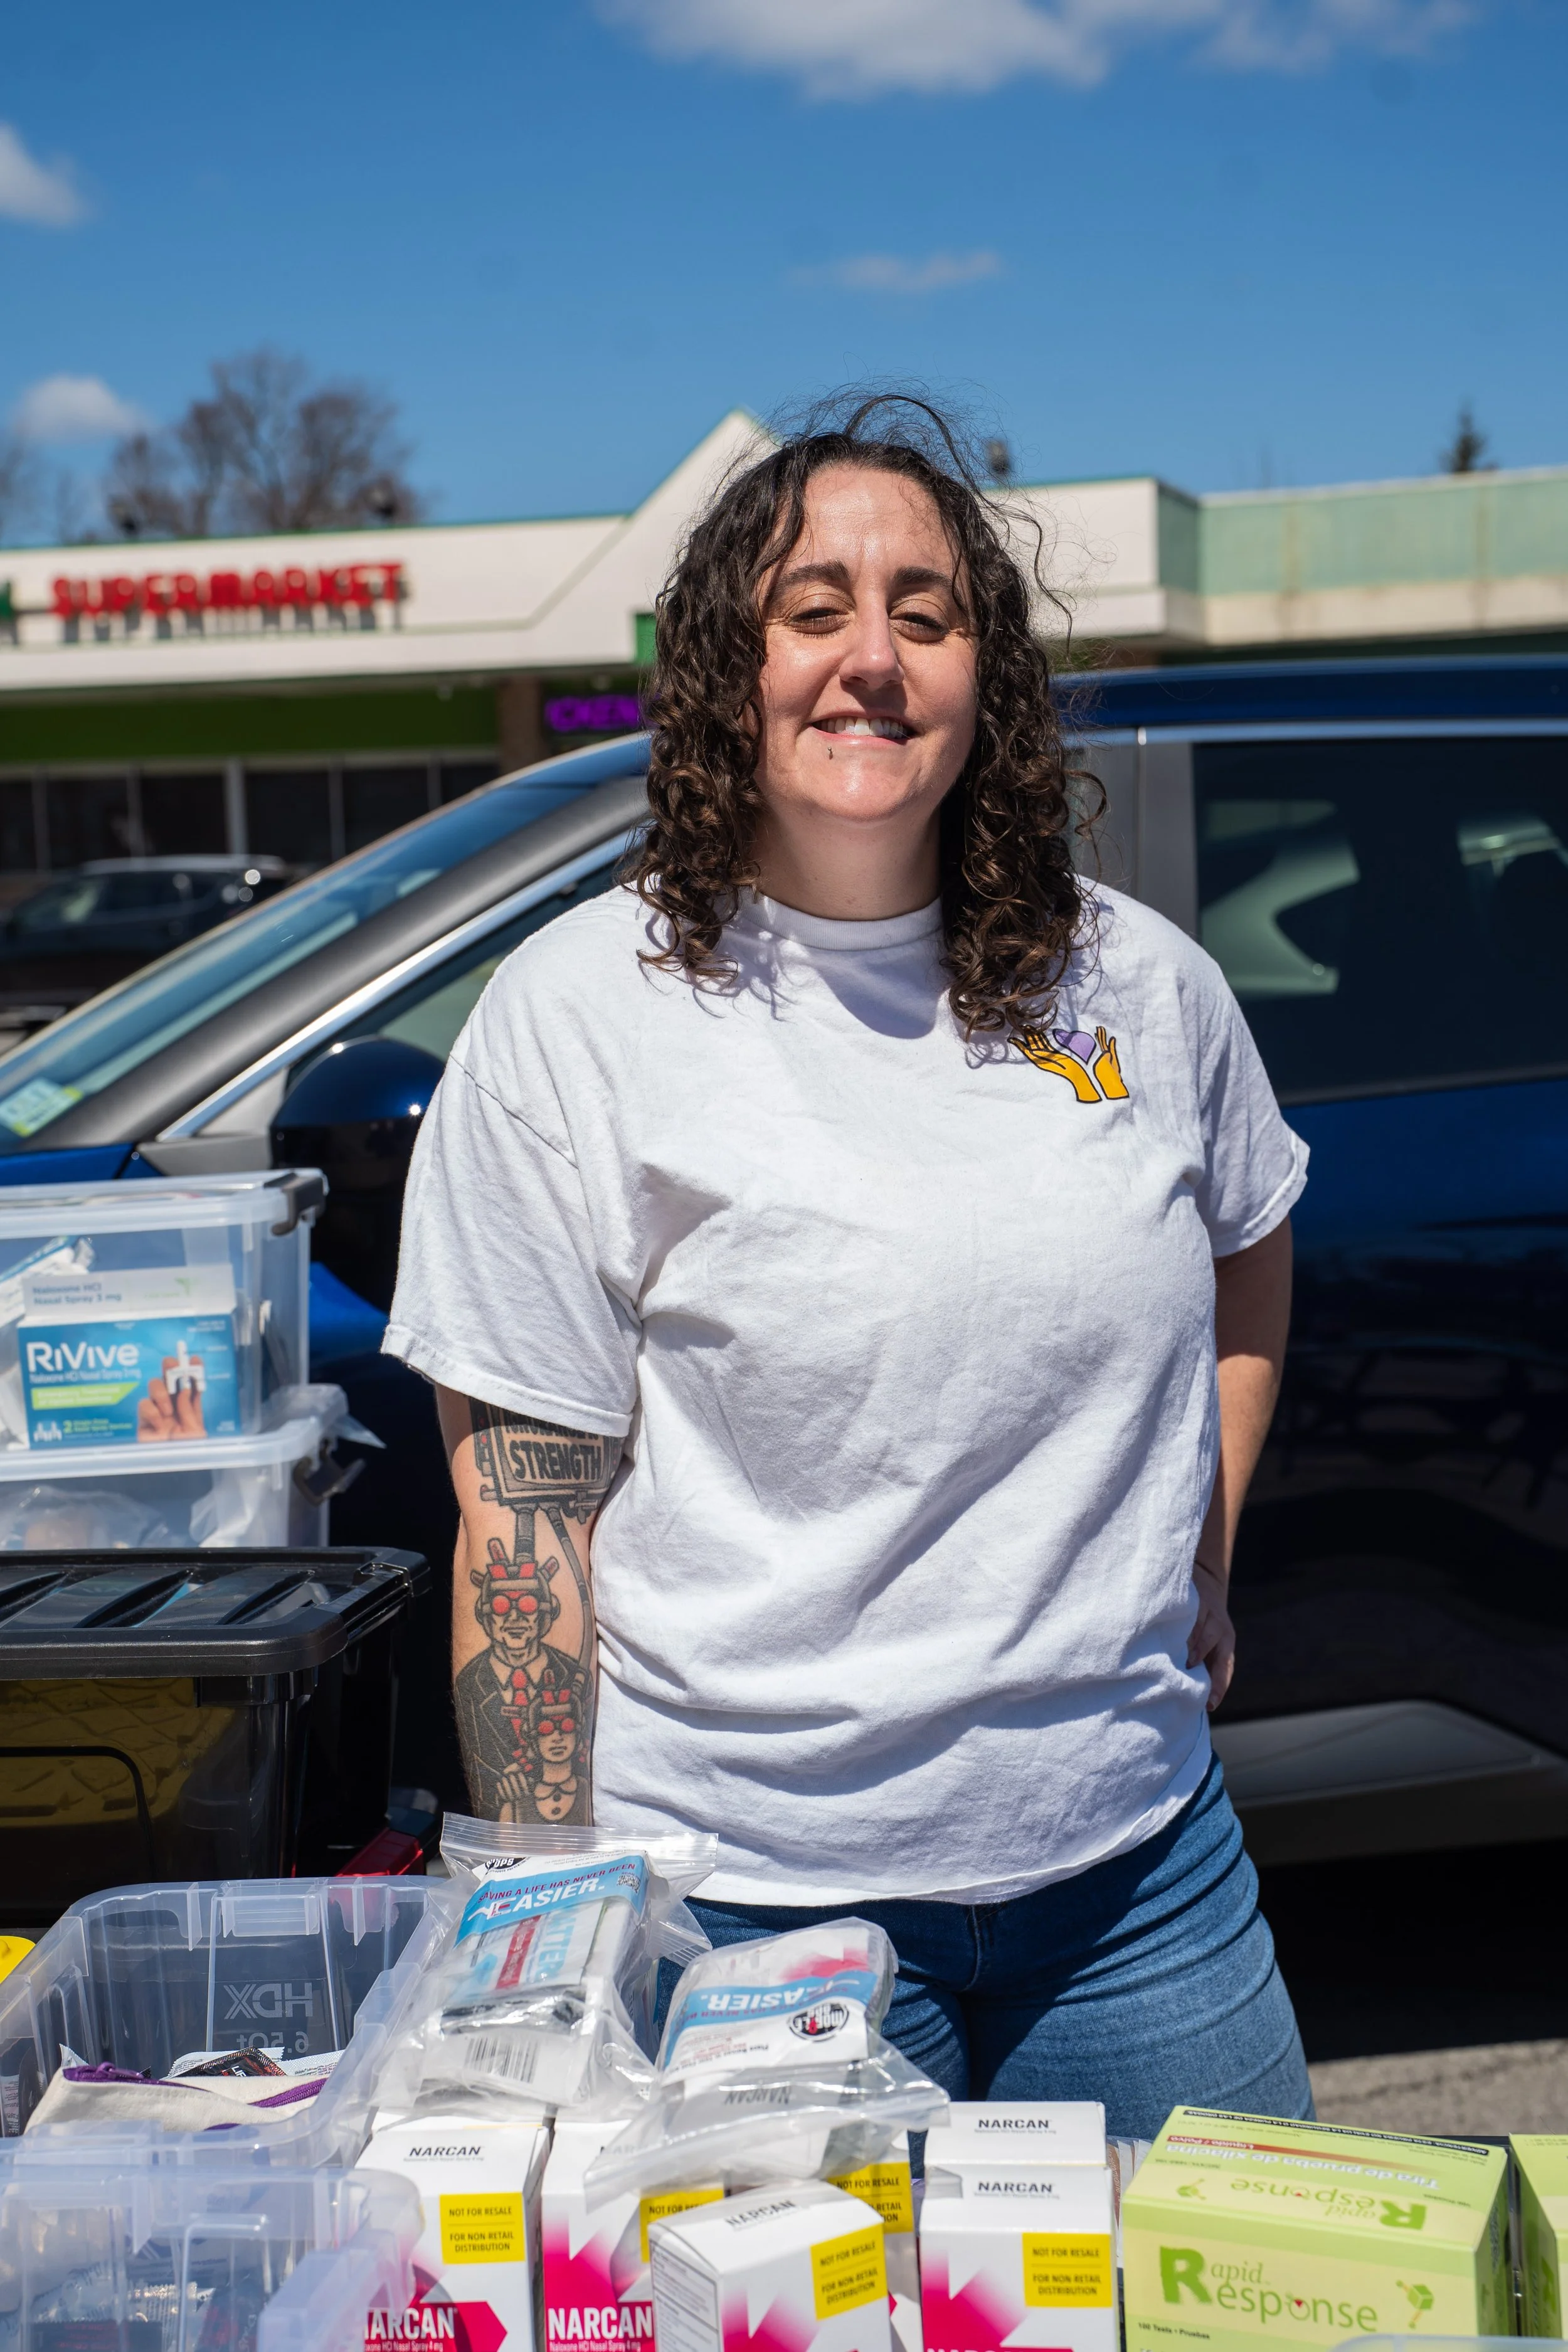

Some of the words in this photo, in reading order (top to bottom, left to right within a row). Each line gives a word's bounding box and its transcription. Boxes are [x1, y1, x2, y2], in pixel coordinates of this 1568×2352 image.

[51, 559, 405, 619] SUPERMARKET
[509, 1440, 601, 1480] STRENGTH
[478, 1890, 515, 1904] SAVING
[516, 1888, 522, 1896] A
[525, 1884, 546, 1894] LIFE
[549, 1880, 569, 1889] HAS
[573, 1871, 605, 1882] NEVER
[609, 1863, 636, 1874] BEEN
[724, 2086, 790, 2104] NARCAN
[978, 2119, 1049, 2129] NARCAN
[410, 2146, 481, 2157] NARCAN
[1167, 2144, 1248, 2159] xilacina
[1252, 2153, 1278, 2164] de
[1283, 2156, 1361, 2174] prueba
[1364, 2167, 1392, 2180] de
[837, 2180, 852, 2190] NOT
[855, 2180, 870, 2189] FOR
[872, 2176, 899, 2187] RESALE
[1397, 2172, 1439, 2190] Tira
[978, 2182, 1052, 2193] NARCAN
[449, 2207, 464, 2217] NOT
[467, 2206, 482, 2217] FOR
[484, 2206, 512, 2216] RESALE
[649, 2205, 665, 2215] NOT
[667, 2205, 683, 2213] FOR
[724, 2200, 796, 2226] NARCAN
[450, 2233, 465, 2242] FOR
[455, 2242, 511, 2253] DISTRIBUTION
[1032, 2248, 1050, 2257] NOT
[1051, 2248, 1067, 2257] FOR
[1070, 2248, 1099, 2258] RESALE
[820, 2257, 835, 2267] NOT
[836, 2250, 850, 2262] FOR
[852, 2241, 876, 2255] RESALE
[1033, 2275, 1049, 2283] FOR
[822, 2283, 836, 2294] FOR
[827, 2281, 876, 2305] DISTRIBUTION
[1038, 2286, 1097, 2295] DISTRIBUTION
[548, 2306, 653, 2340] NARCAN
[549, 2341, 578, 2351] Naloxone
[590, 2341, 607, 2351] Nasal
[608, 2340, 625, 2352] Spray
